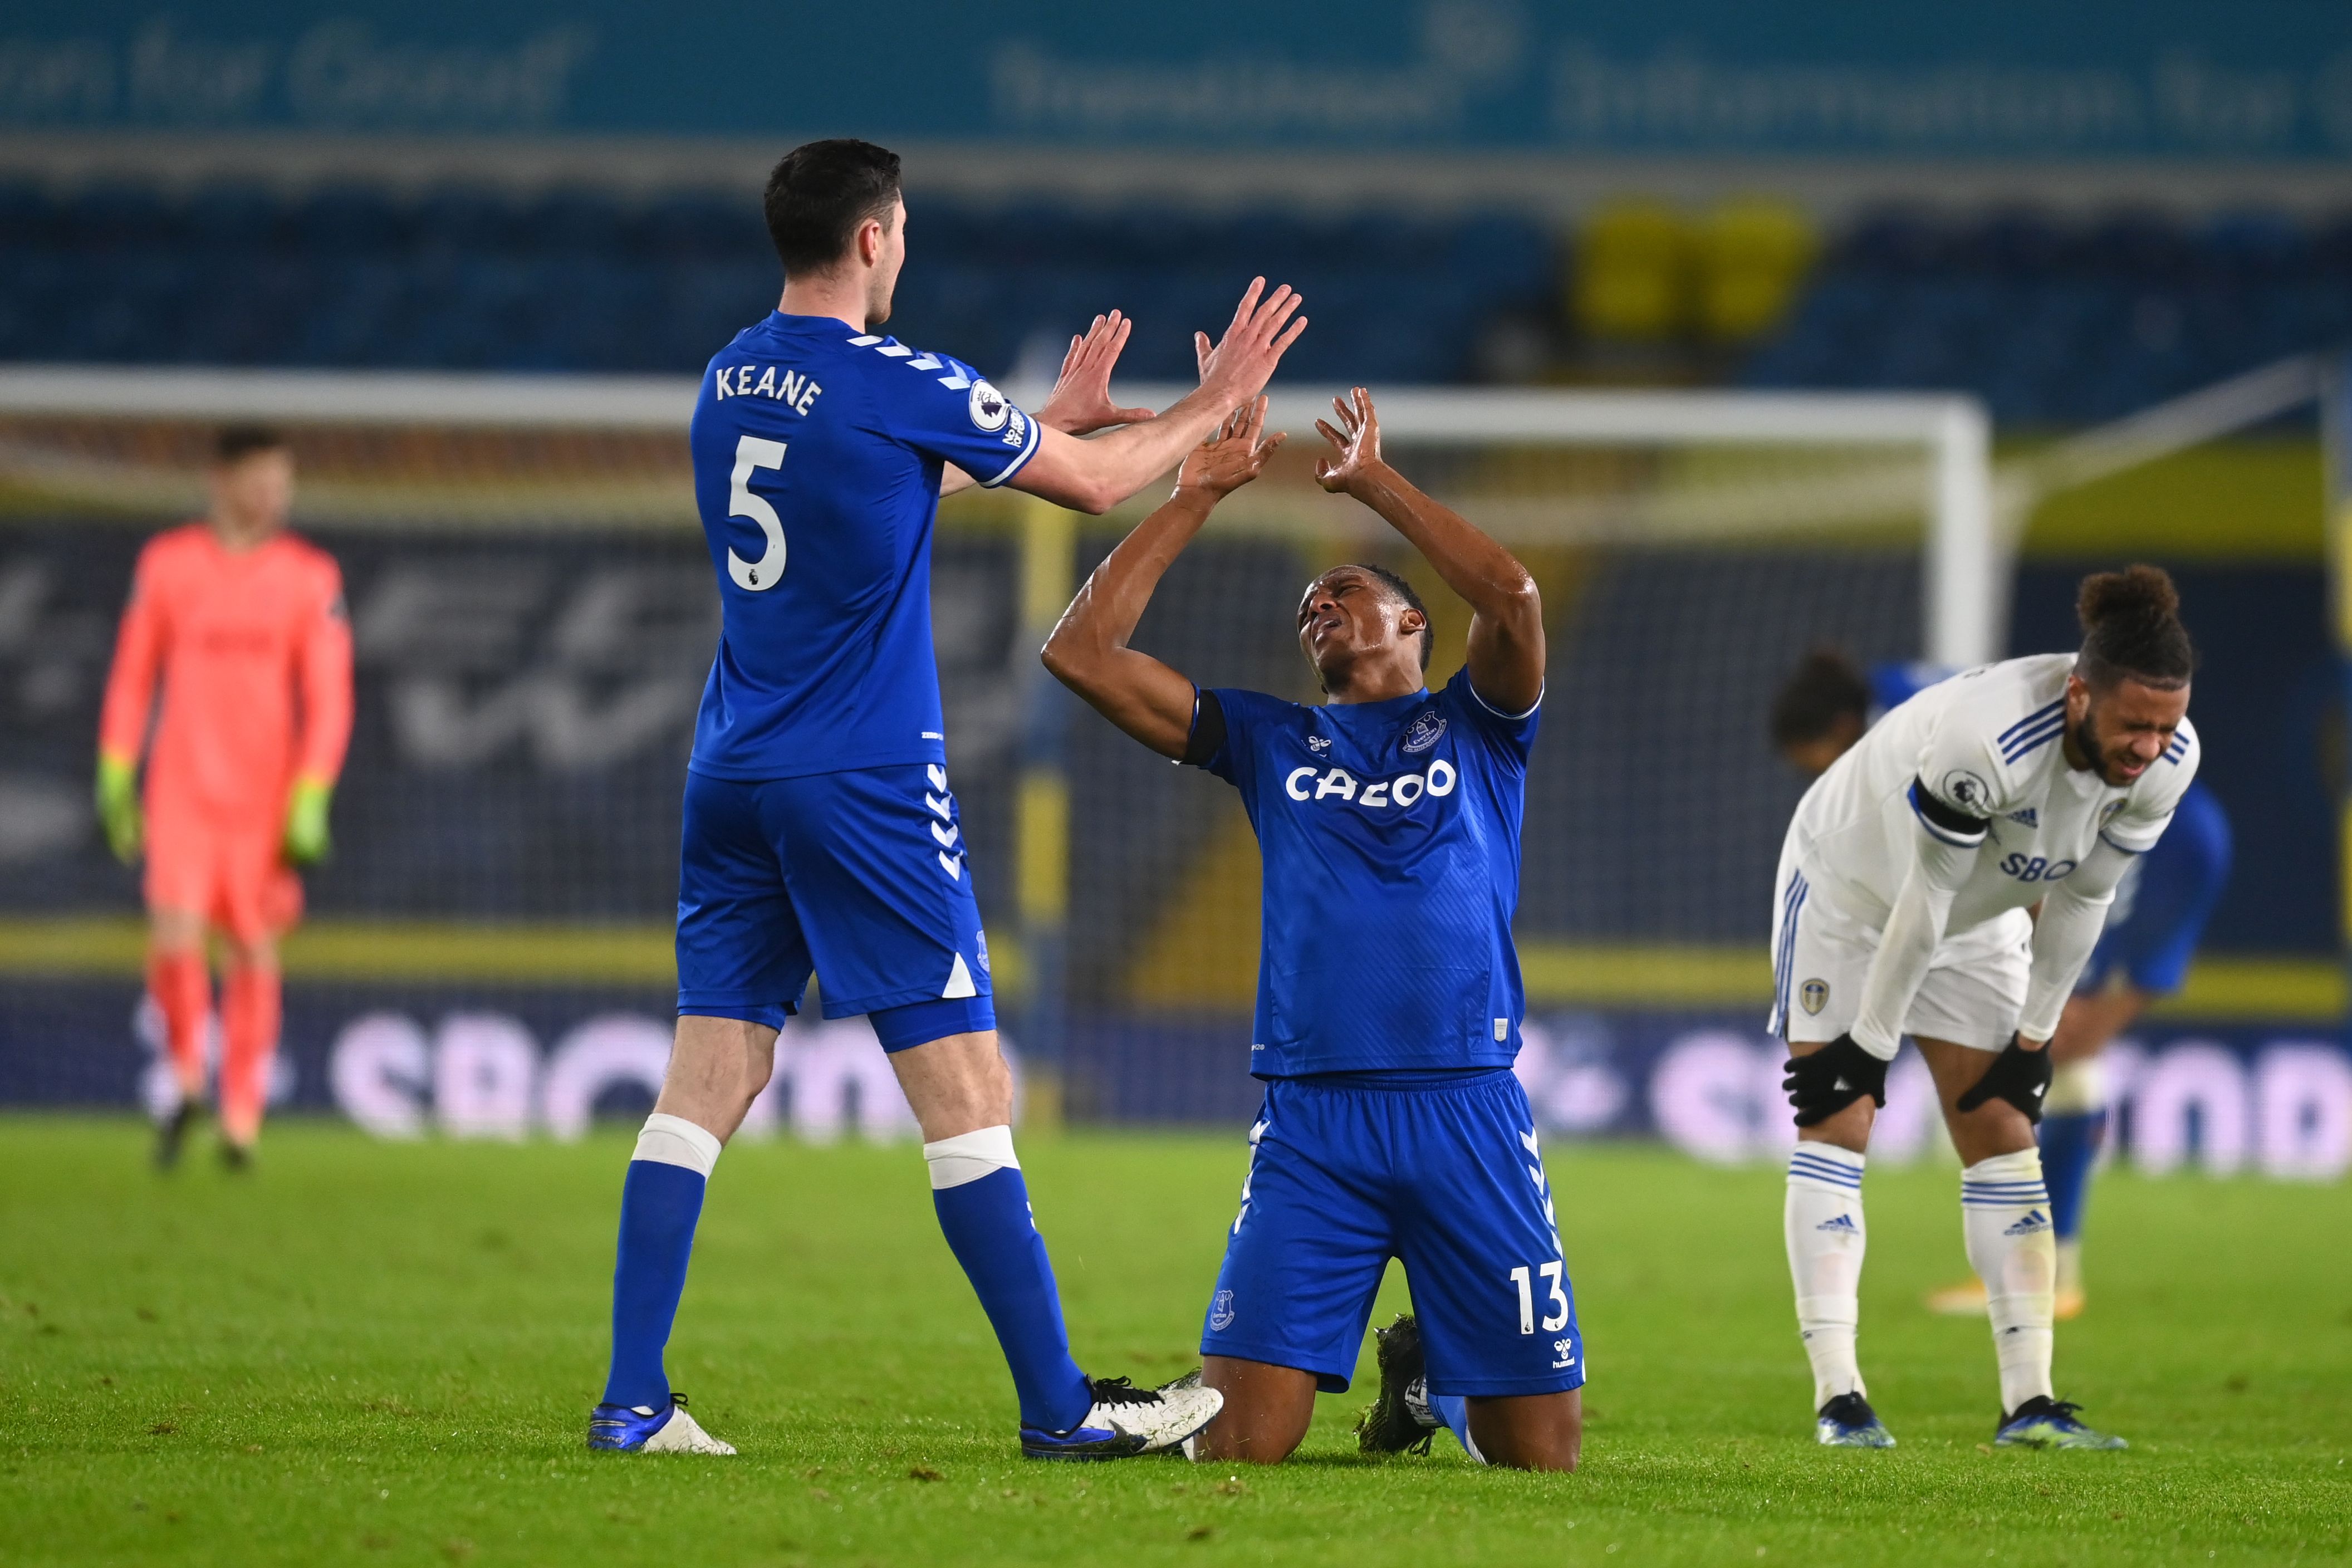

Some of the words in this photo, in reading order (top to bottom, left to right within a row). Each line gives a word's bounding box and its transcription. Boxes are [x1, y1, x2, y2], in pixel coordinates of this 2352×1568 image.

[716, 365, 822, 416] KEANE
[1002, 429, 1015, 445] No
[728, 434, 788, 592] 5
[1413, 727, 1437, 744] Everton
[1286, 759, 1457, 807] CAZOO
[1510, 1260, 1570, 1335] 13
[1552, 1355, 1575, 1369] hummel
